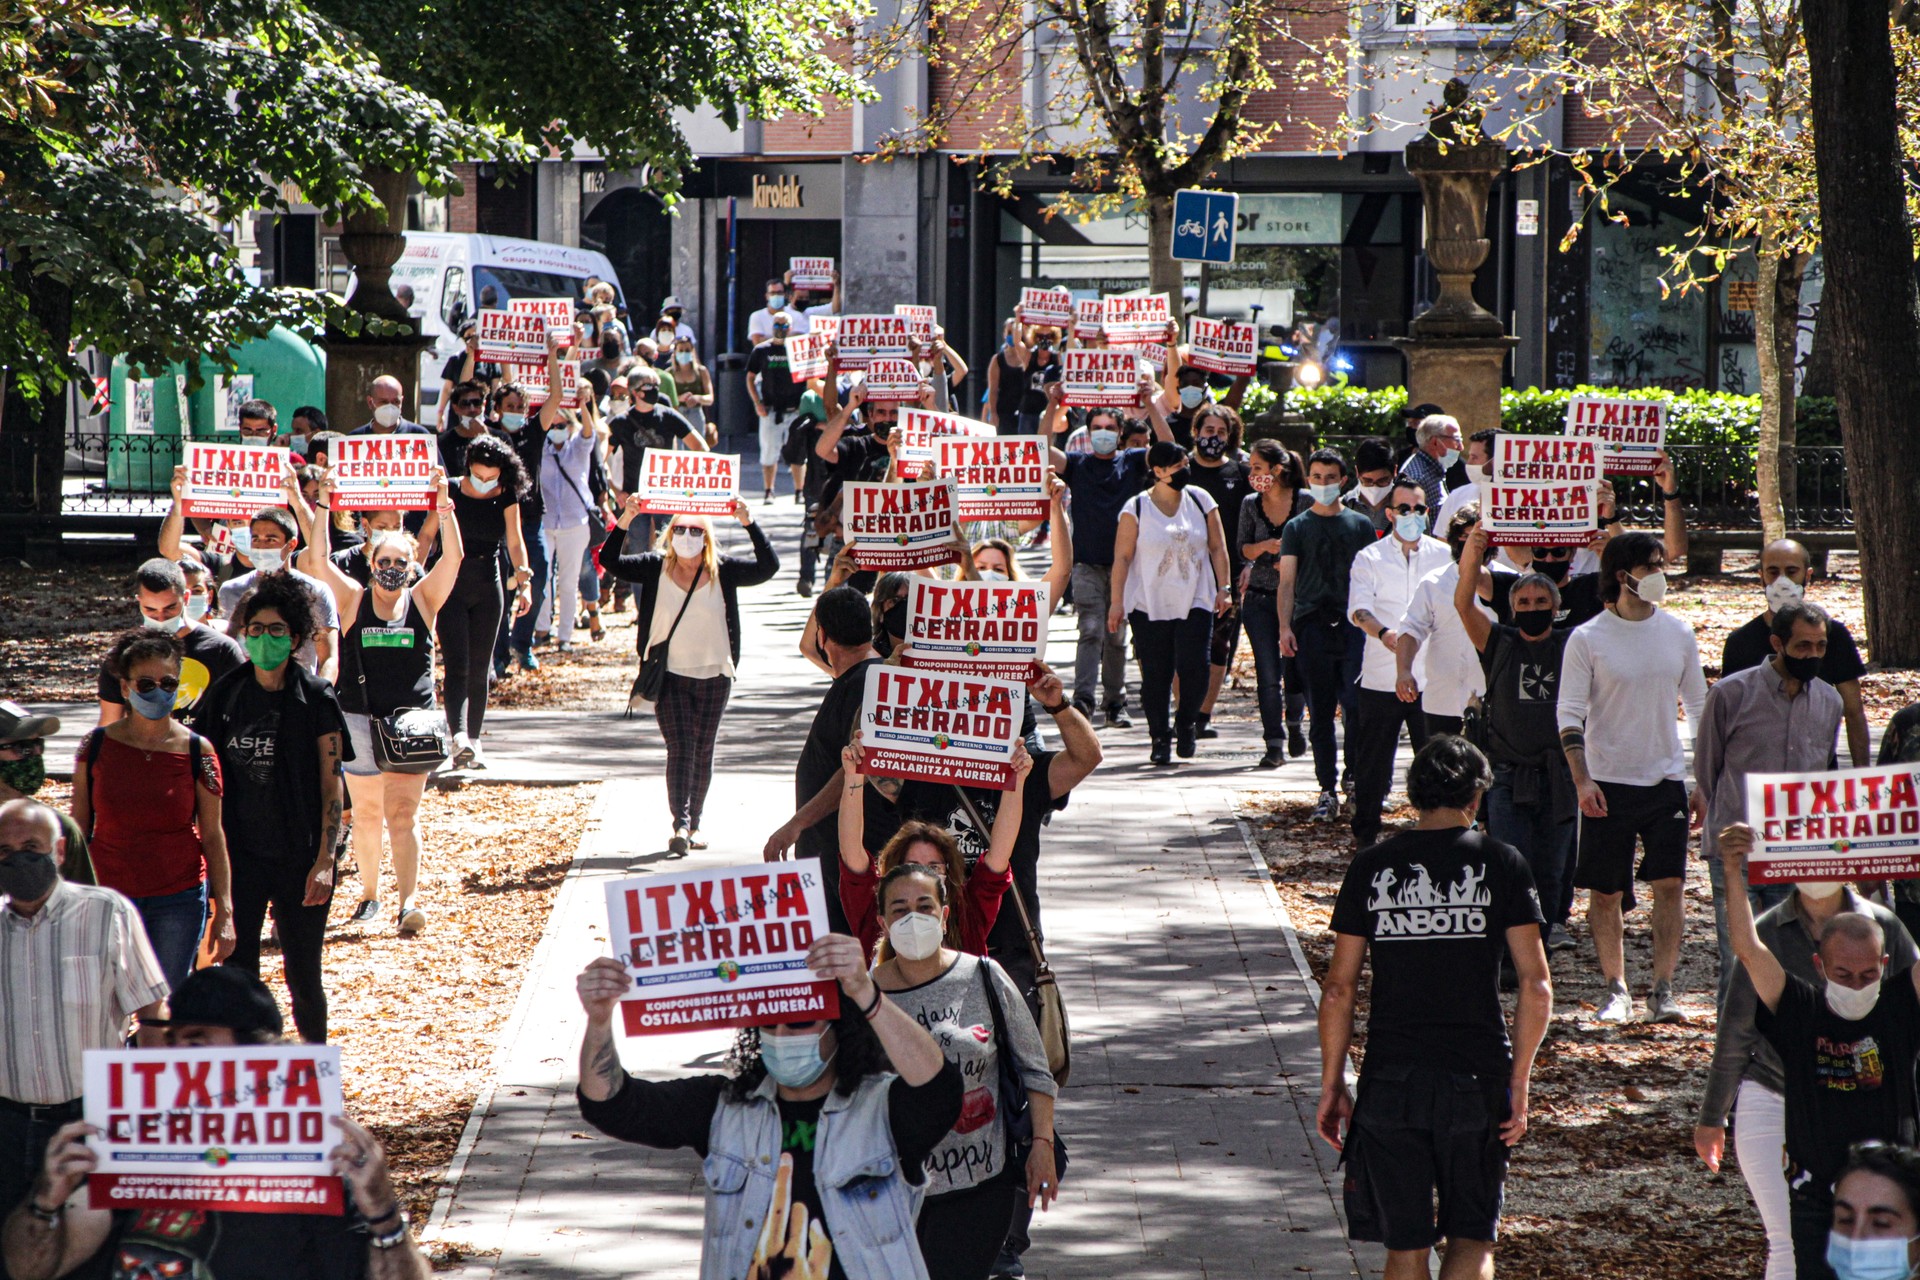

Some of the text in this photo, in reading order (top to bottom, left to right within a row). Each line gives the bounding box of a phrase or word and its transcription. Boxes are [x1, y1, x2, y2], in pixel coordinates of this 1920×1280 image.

[753, 174, 801, 208] kirolak
[1267, 222, 1310, 232] STORE
[795, 260, 830, 268] ITXITA
[1104, 280, 1141, 288] nueva
[1027, 291, 1069, 304] ITXITA
[1108, 298, 1165, 312] ITXITA
[513, 303, 568, 315] ITXITA
[899, 307, 932, 315] ITXITA
[1026, 302, 1070, 312] CERRADO
[482, 313, 544, 332] ITXITA
[840, 318, 905, 334] ITXITA
[1107, 313, 1166, 323] CERRADO
[481, 329, 544, 343] CERRADO
[1196, 321, 1253, 341] ITXITA
[839, 336, 906, 347] CERRADO
[1195, 336, 1252, 353] CERRADO
[867, 362, 915, 373] ITXITA
[1066, 354, 1135, 371] ITXITA
[867, 374, 917, 383] CERRADO
[1066, 371, 1135, 383] CERRADO
[1576, 402, 1660, 427] ITXITA
[1575, 425, 1659, 443] CERRADO
[338, 440, 429, 460] ITXITA
[941, 441, 1040, 466] ITXITA
[1504, 440, 1595, 464] ITXITA
[193, 448, 280, 473] ITXITA
[649, 454, 731, 476] ITXITA
[339, 462, 429, 477] CERRADO
[941, 467, 1042, 484] CERRADO
[1503, 463, 1595, 480] CERRADO
[191, 471, 280, 489] CERRADO
[648, 475, 731, 489] CERRADO
[854, 485, 950, 514] ITXITA
[1491, 485, 1588, 507] ITXITA
[190, 506, 243, 515] OSTALARITZA
[647, 504, 696, 512] OSTALARITZA
[1492, 506, 1589, 520] CERRADO
[853, 510, 951, 533] CERRADO
[854, 551, 952, 566] OSTALARITZA AURERA!
[916, 584, 1038, 619] ITXITA
[912, 616, 1038, 642] CERRADO
[914, 661, 974, 670] KONPONBIDEAK
[976, 663, 996, 671] NAHI
[990, 670, 1034, 680] AURERA!
[878, 672, 1011, 715] ITXITA
[942, 689, 1020, 710] TRABAJAR
[875, 705, 1011, 740] CERRADO
[897, 734, 930, 743] JAURLARITZA
[953, 741, 983, 749] GOBIERNO
[877, 751, 999, 771] KONPONBIDEAK NAHI DITUGU!
[870, 759, 1005, 783] OSTALARITZA AURERA!
[1764, 773, 1918, 817] ITXITA
[1764, 811, 1919, 841] CERRADO
[1764, 863, 1920, 877] OSTALARITZA AURERA!
[1771, 860, 1844, 868] KONPONBIDEAK
[625, 872, 809, 934] ITXITA
[717, 872, 816, 923] TRABAJAR
[630, 920, 815, 969] CERRADO
[745, 963, 784, 973] GOBIERNO
[642, 970, 713, 985] EUSKO JAURLARITZA
[646, 985, 812, 1012] KONPONBIDEAK NAHI DITUGU!
[640, 995, 824, 1027] OSTALARITZA AURERA!
[108, 1059, 322, 1109] ITXITA
[108, 1112, 323, 1145] CERRADO
[119, 1177, 314, 1188] KONPONBIDEAK NAHI DITUGU!
[110, 1187, 327, 1204] OSTALARITZA AURERA!
